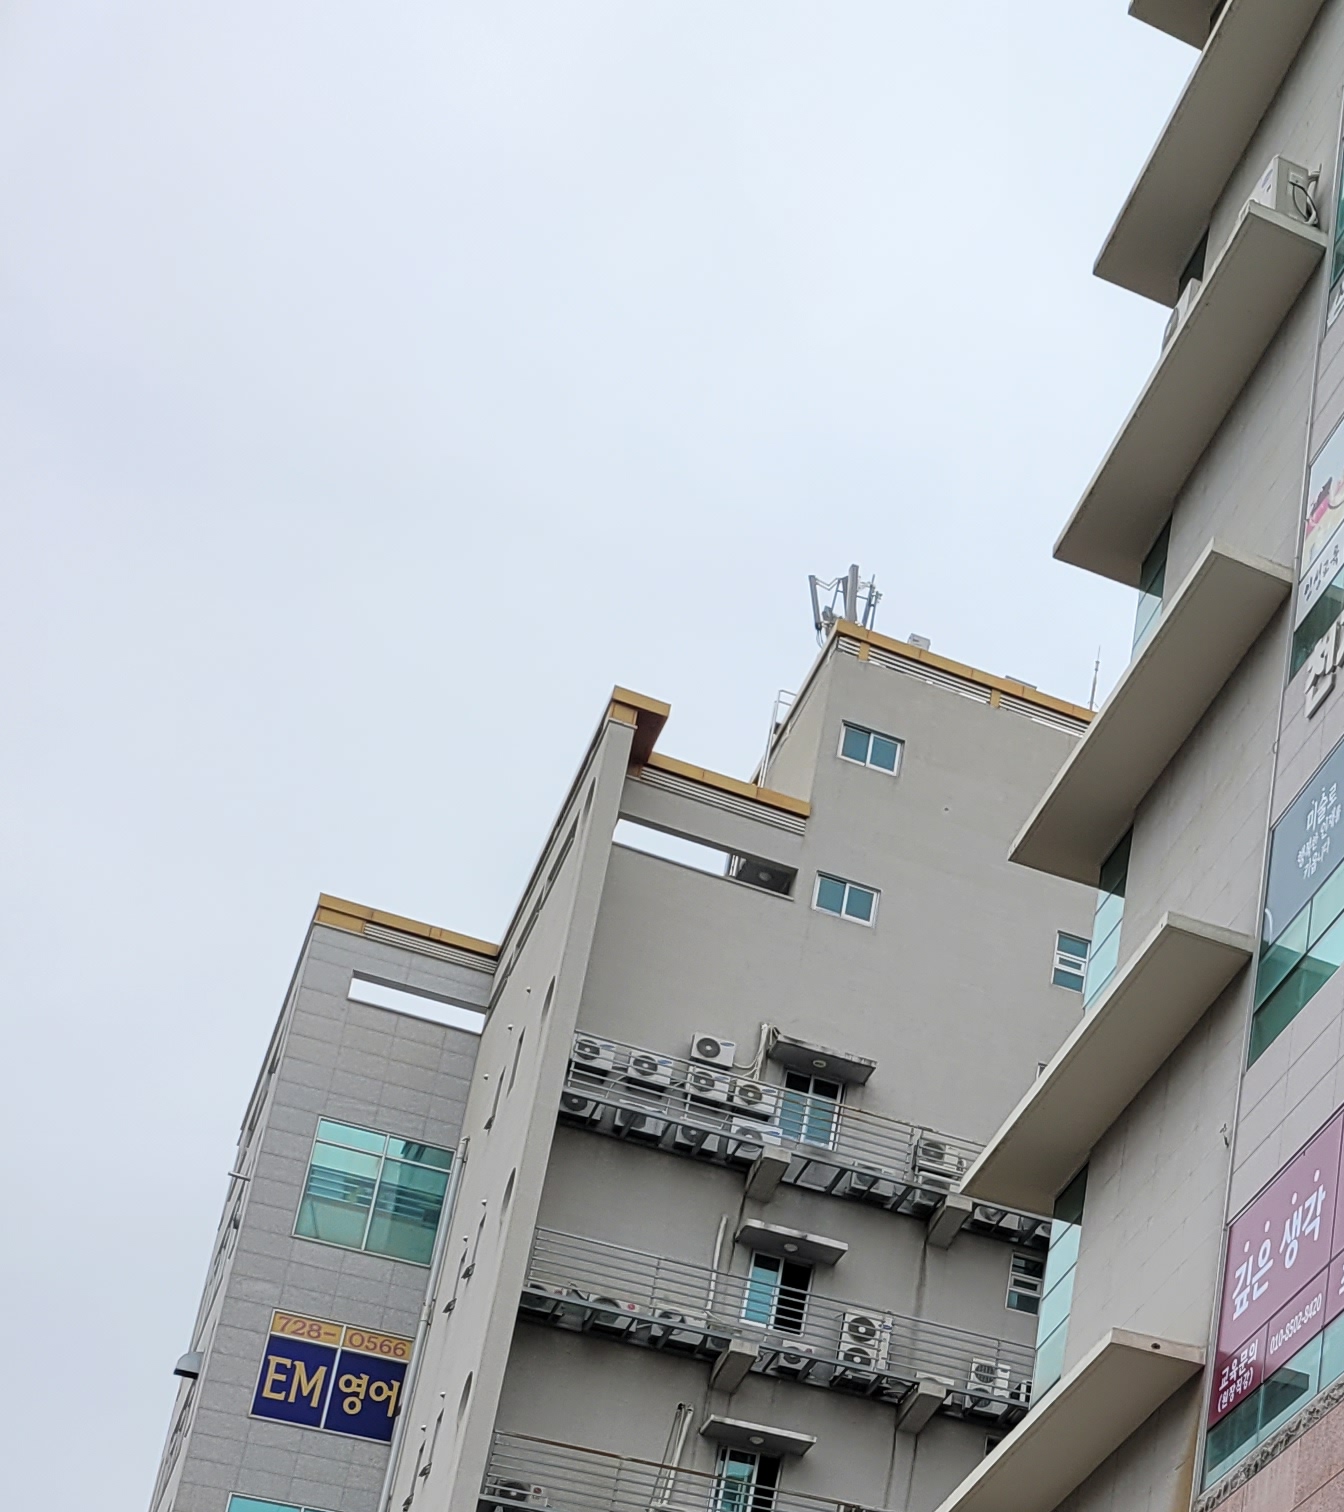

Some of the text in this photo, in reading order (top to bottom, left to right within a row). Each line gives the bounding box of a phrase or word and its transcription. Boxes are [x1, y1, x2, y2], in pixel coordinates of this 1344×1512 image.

[1233, 1170, 1326, 1320] 깊은 생각
[261, 1355, 401, 1418] EM 영어
[1218, 1339, 1258, 1391] 교육문의
